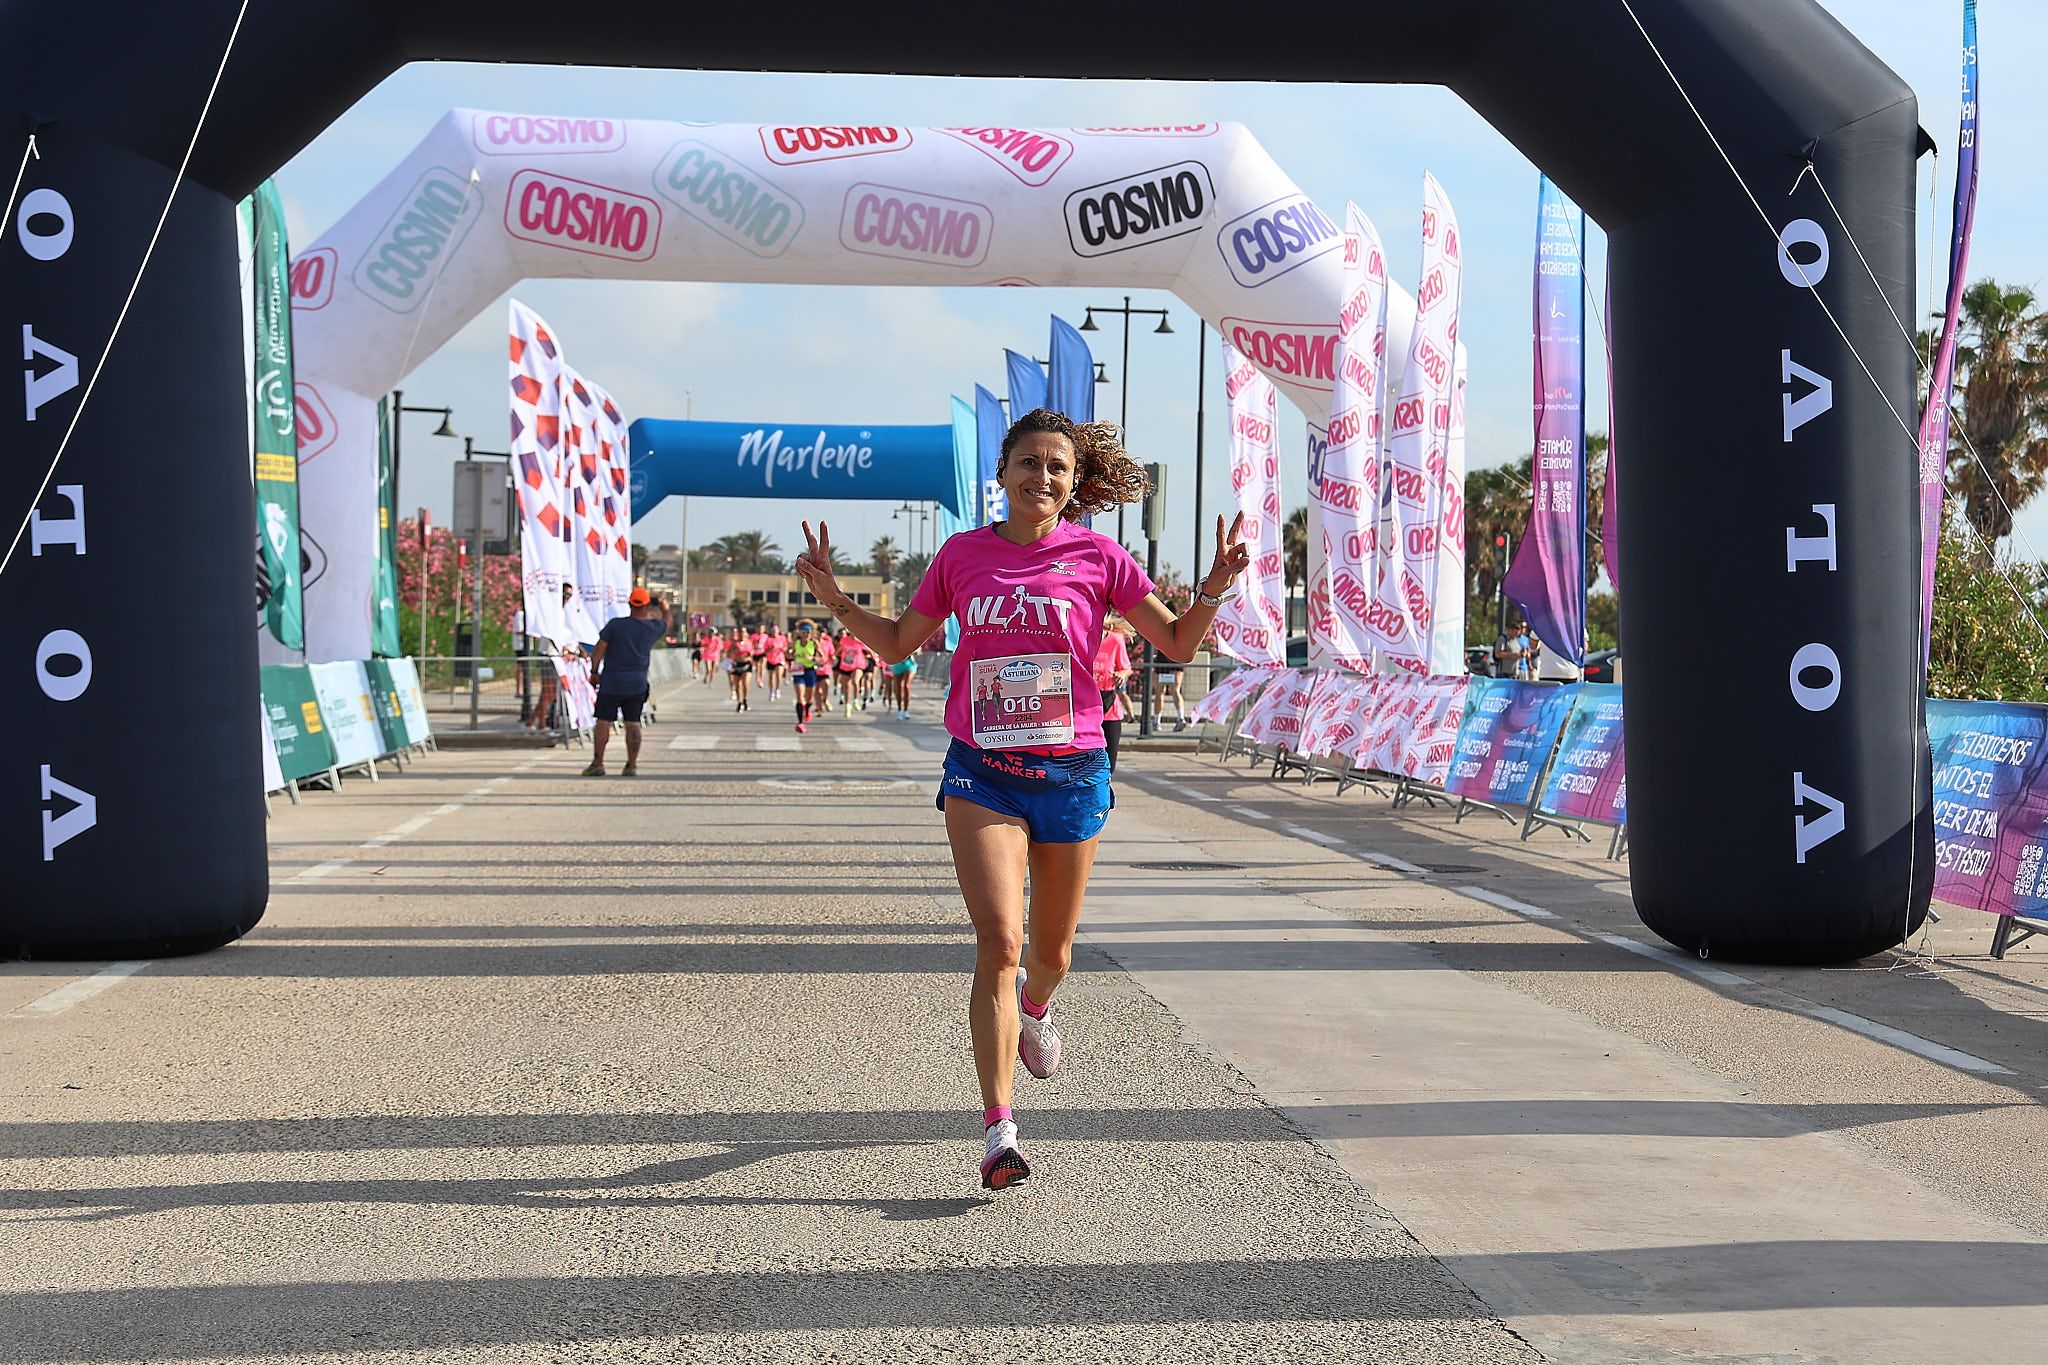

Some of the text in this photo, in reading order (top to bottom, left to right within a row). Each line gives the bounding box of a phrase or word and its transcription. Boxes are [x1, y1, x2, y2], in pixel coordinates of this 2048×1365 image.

[486, 116, 614, 145] COSMO
[945, 127, 1060, 173] SMO
[520, 181, 649, 253] COSMO
[667, 148, 791, 248] COSMO
[1078, 171, 1205, 246] COSMO
[367, 180, 469, 299] COSMO
[853, 193, 981, 259] COSMO
[1232, 200, 1338, 275] COSMO
[16, 188, 97, 862] VOLVO
[1777, 218, 1846, 865] VOLVO
[1002, 669, 1039, 678] ASTURIANA
[1003, 695, 1042, 714] 016
[1270, 715, 1300, 734] COSMO
[983, 724, 1005, 732] CARRERA
[984, 734, 1016, 744] OYSHO
[982, 754, 1047, 779] HANKER
[1426, 744, 1456, 763] COSM
